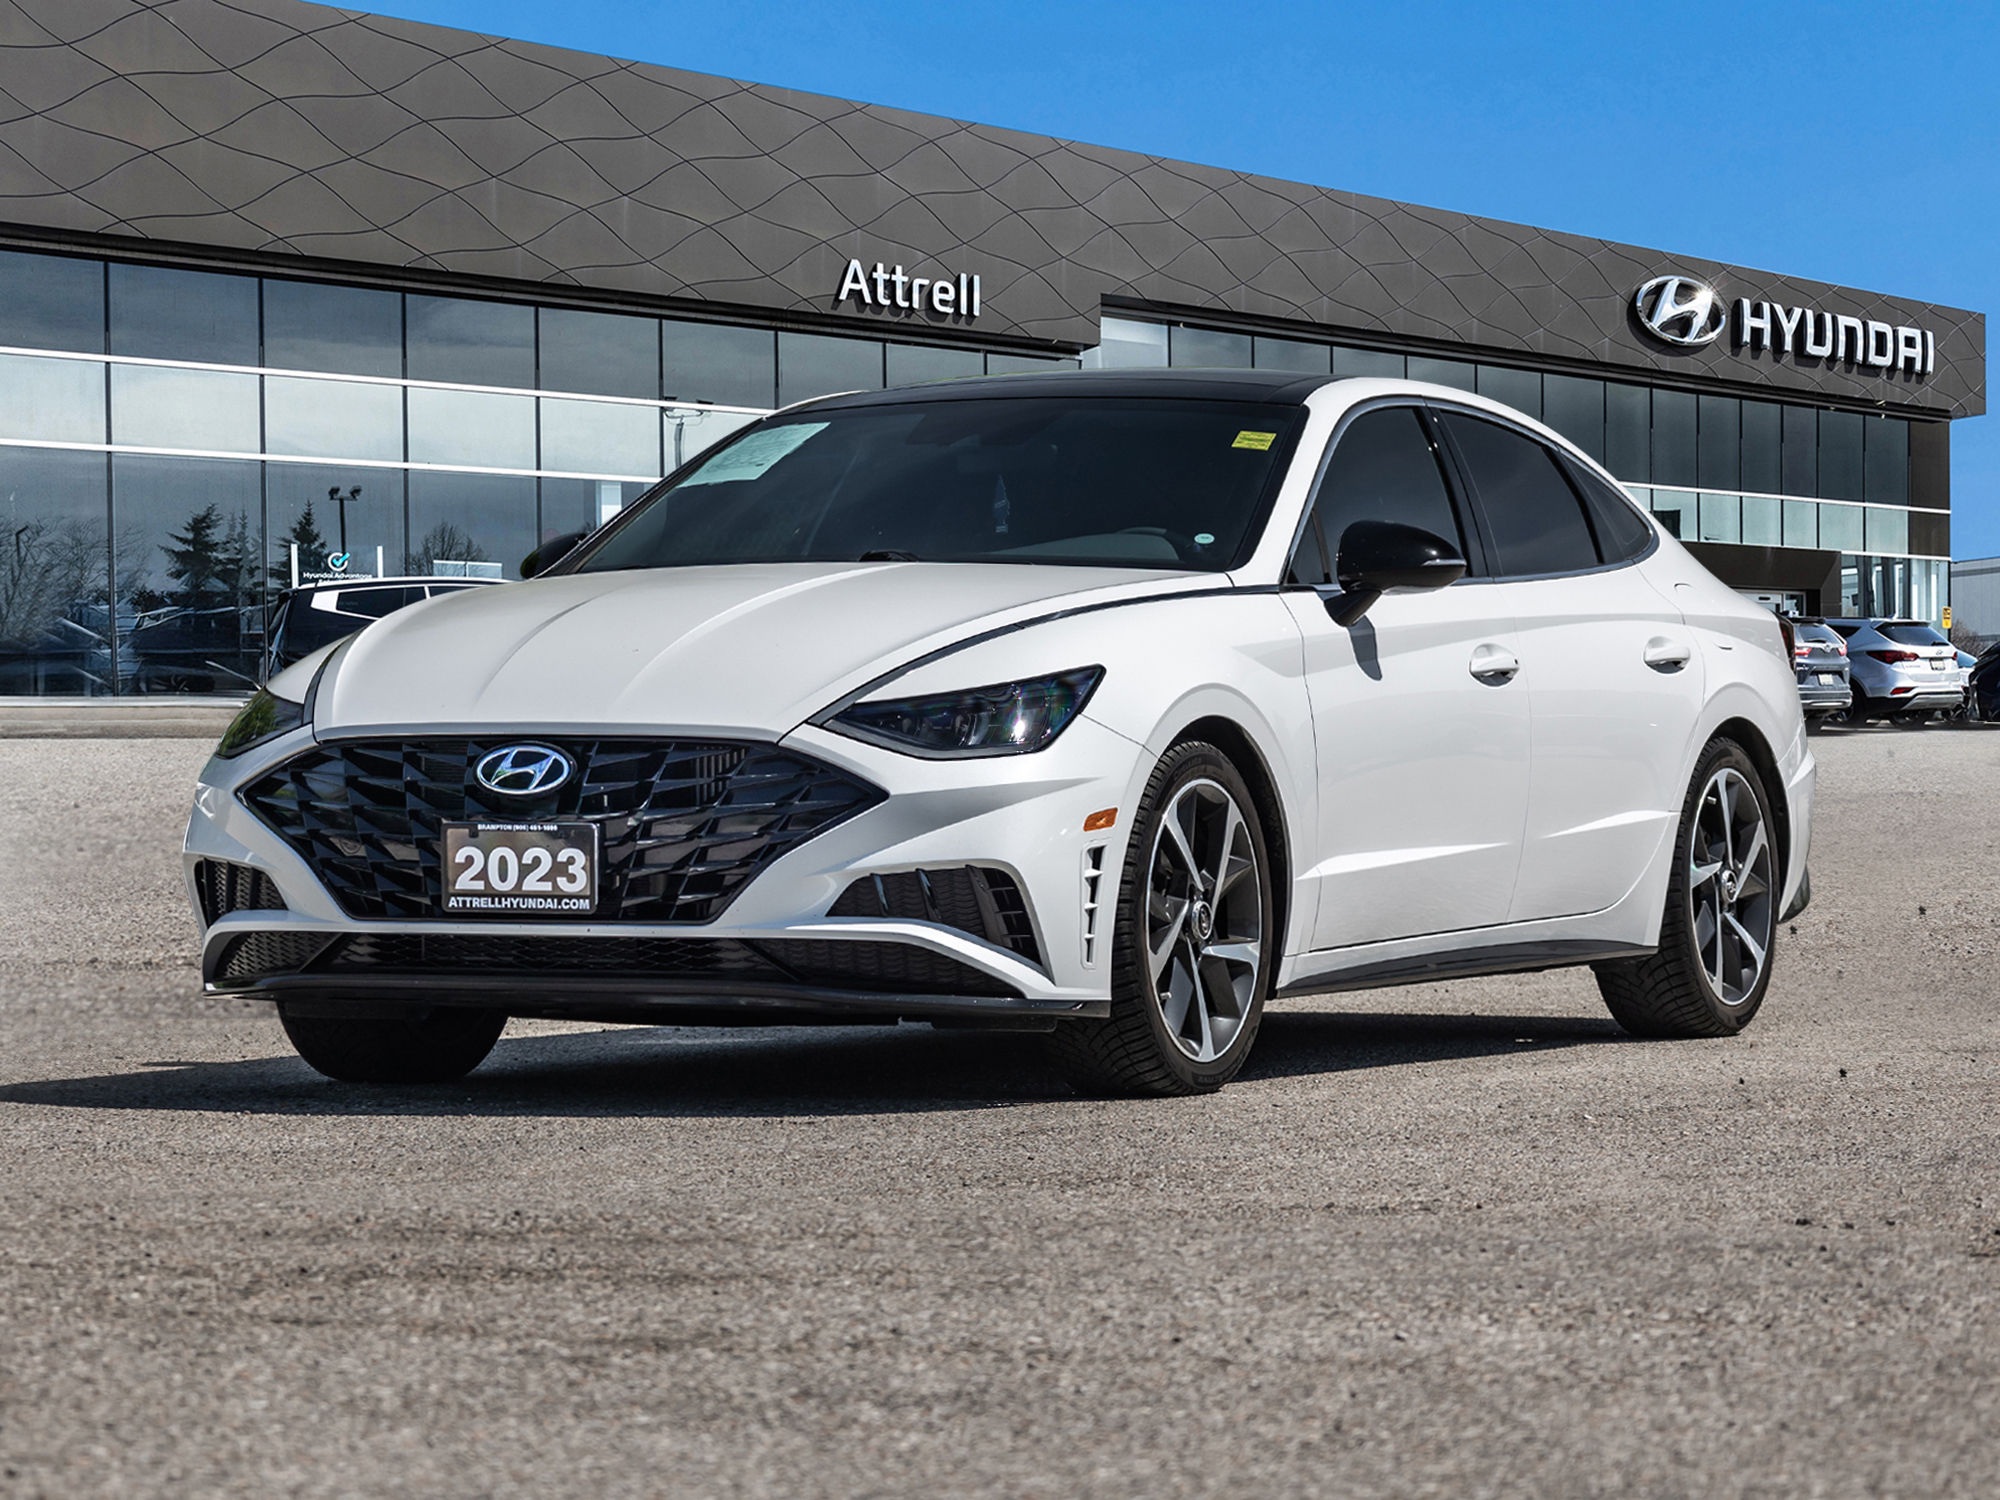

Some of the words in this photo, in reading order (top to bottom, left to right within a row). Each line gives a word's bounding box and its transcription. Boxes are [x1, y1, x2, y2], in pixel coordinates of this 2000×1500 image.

[839, 258, 981, 317] Attrell
[1739, 297, 1935, 375] HYUNDAI
[455, 845, 588, 893] 2023
[448, 896, 590, 910] ATTRELLHYUNDAI.COM
